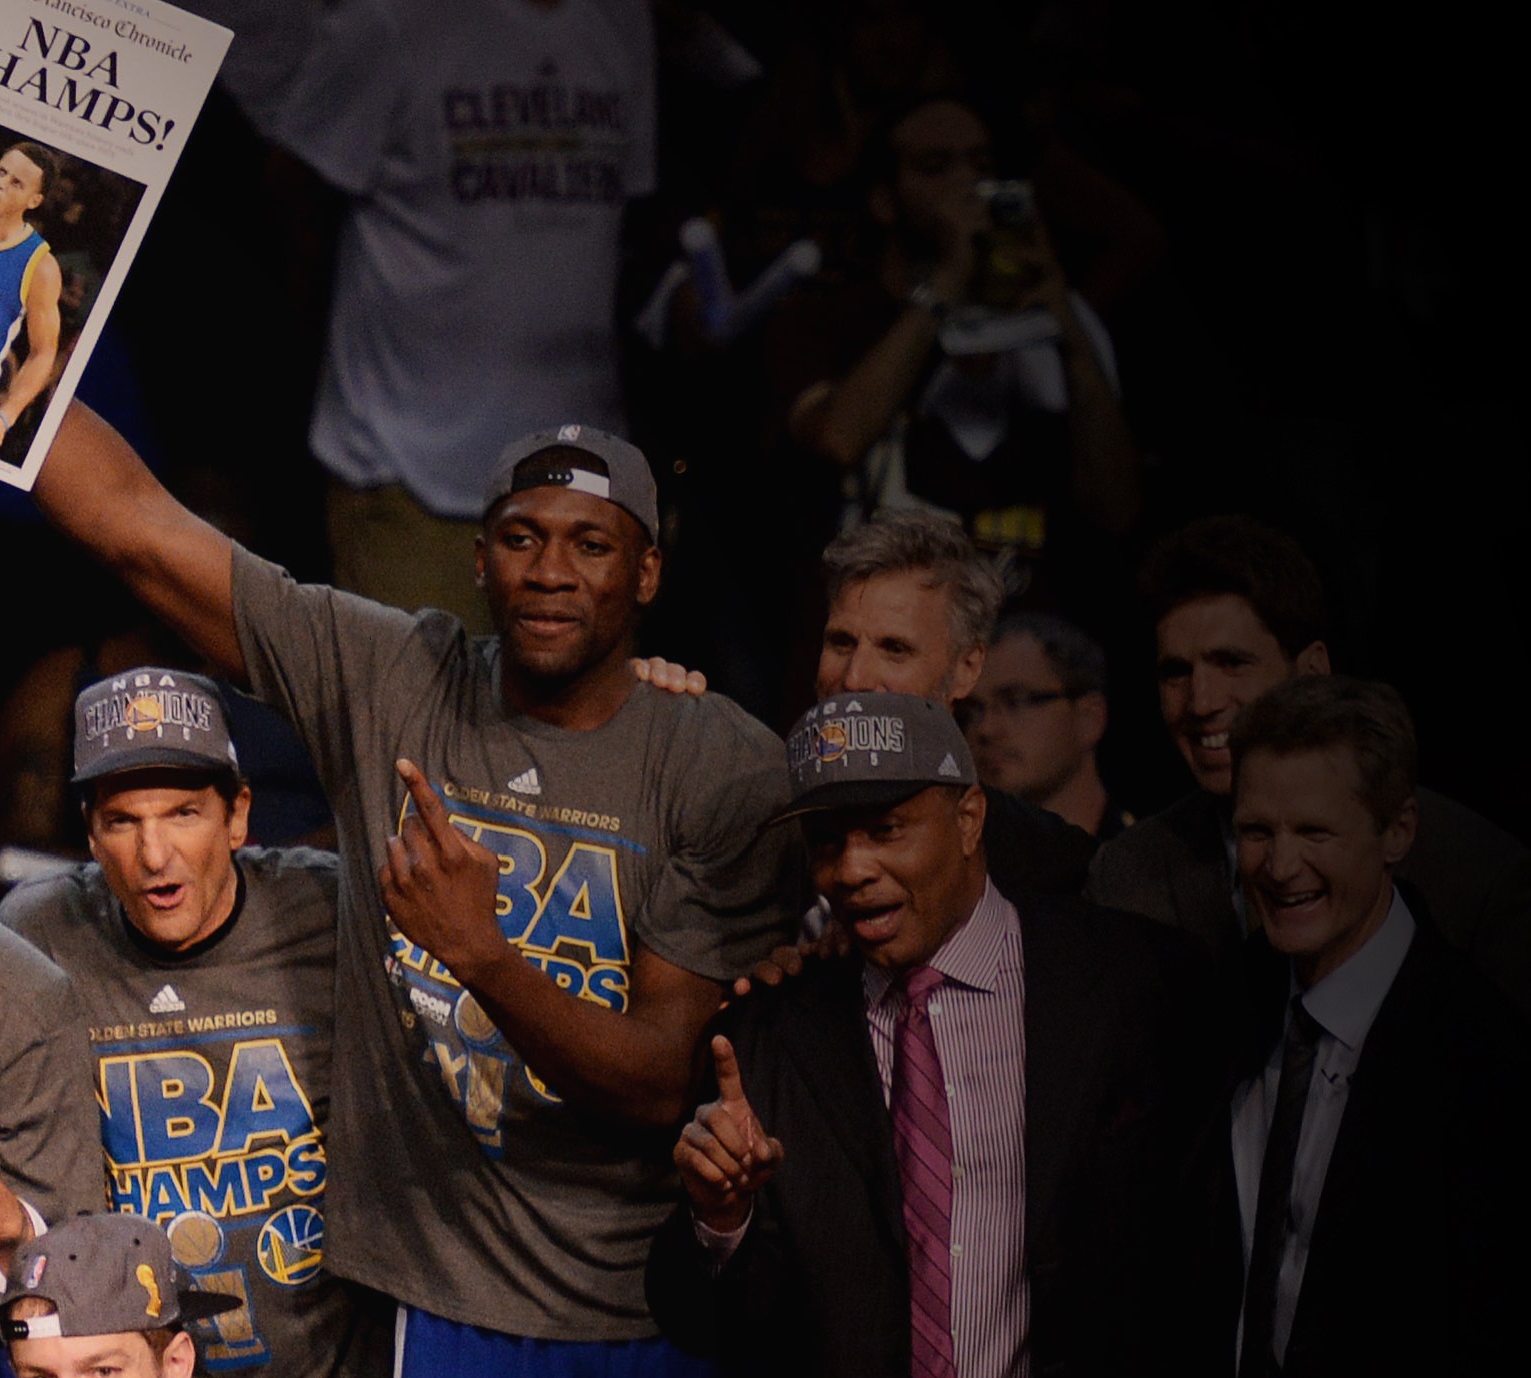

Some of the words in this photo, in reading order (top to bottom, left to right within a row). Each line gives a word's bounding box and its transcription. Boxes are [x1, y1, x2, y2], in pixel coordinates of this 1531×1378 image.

[17, 17, 120, 89] NBA
[115, 21, 193, 63] Chronicle
[540, 807, 621, 832] WARRIORS
[137, 1019, 184, 1037] STATE
[187, 1009, 278, 1033] WARRIORS
[94, 1038, 321, 1170] NBA
[107, 1139, 328, 1226] HAMPS
